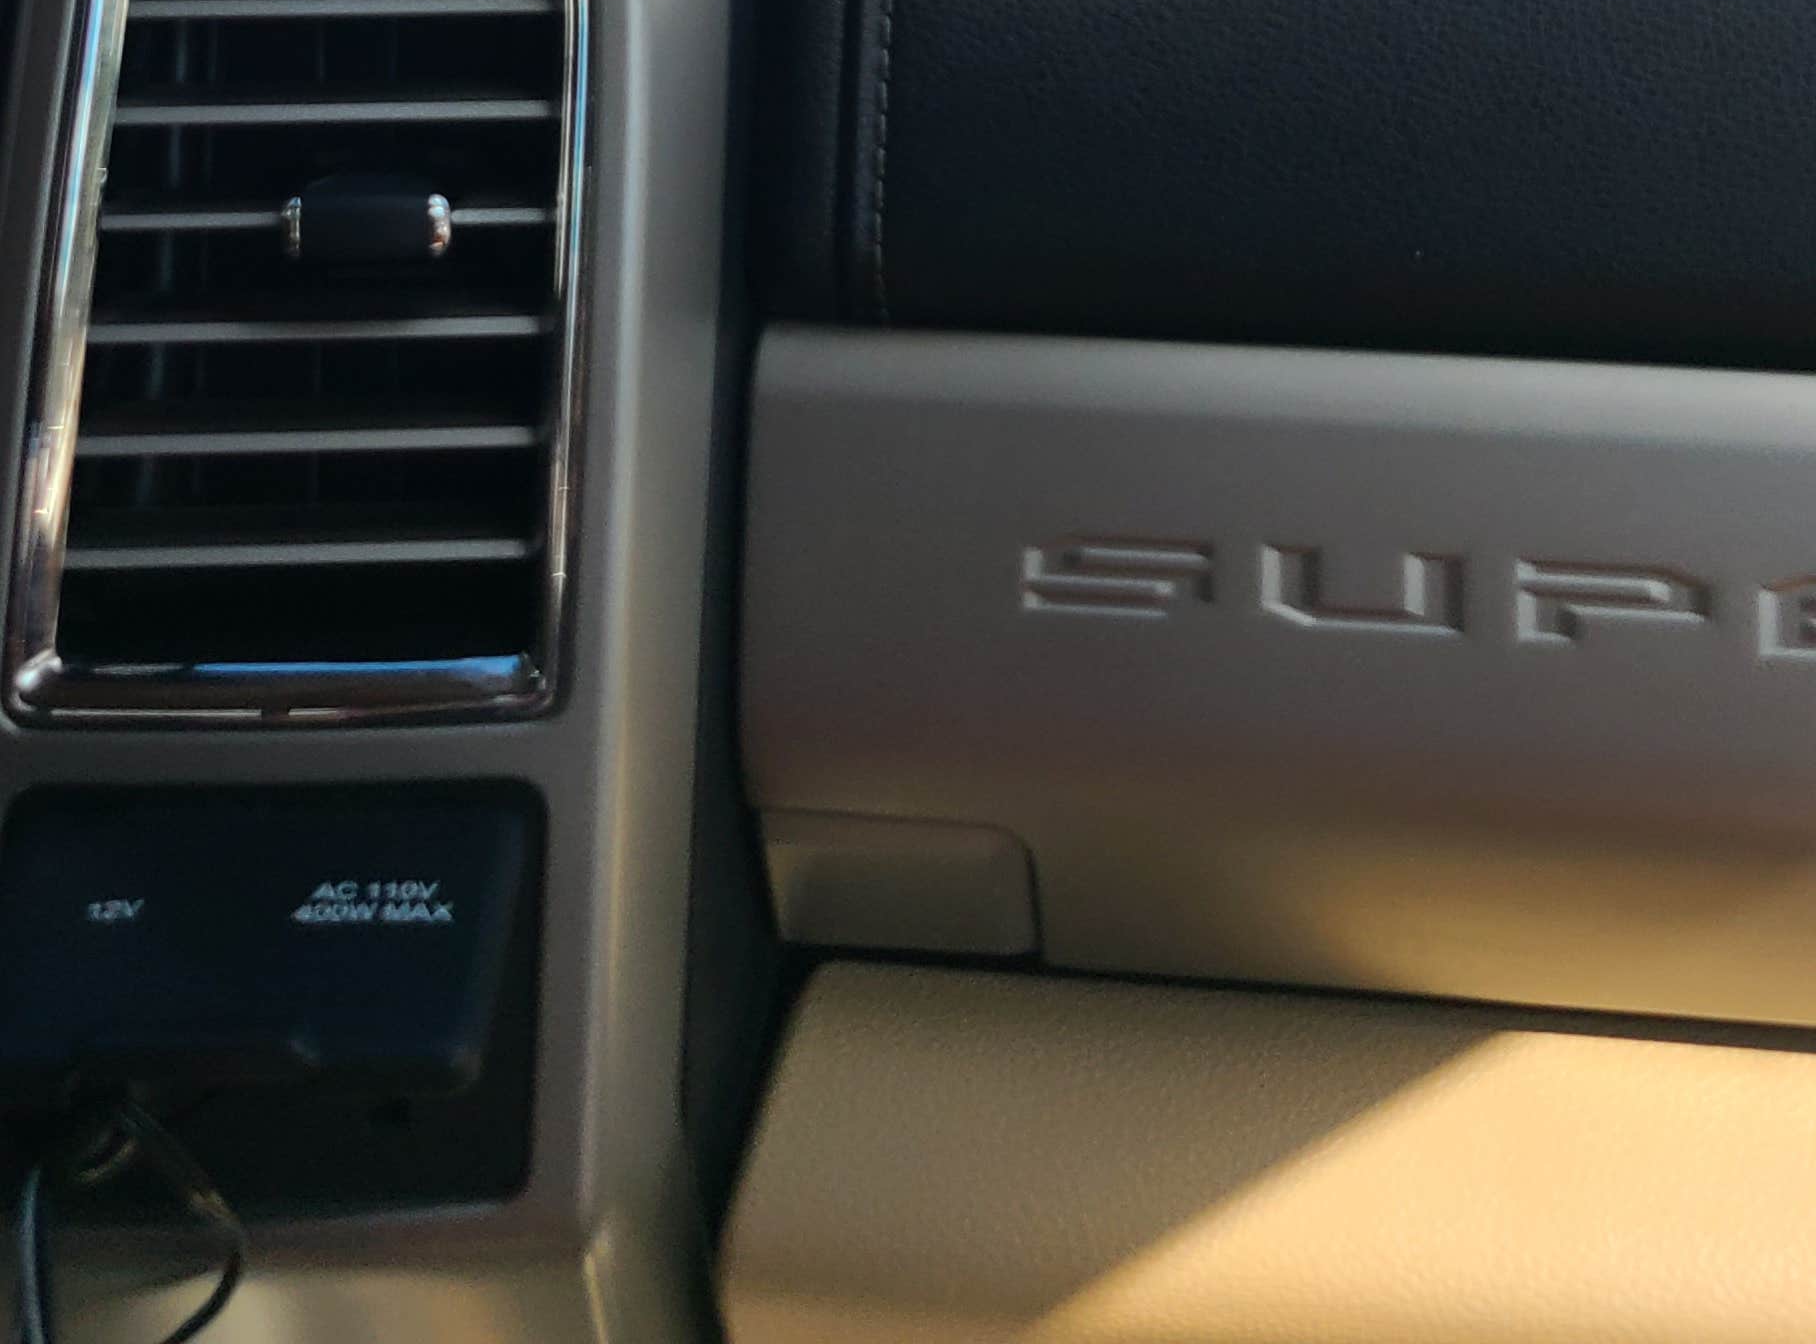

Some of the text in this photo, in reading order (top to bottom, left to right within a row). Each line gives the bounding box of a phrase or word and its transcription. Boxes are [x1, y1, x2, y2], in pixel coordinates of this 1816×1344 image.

[312, 880, 439, 900] AC 110V
[87, 898, 144, 921] 12V
[293, 901, 453, 921] 400W MAX
